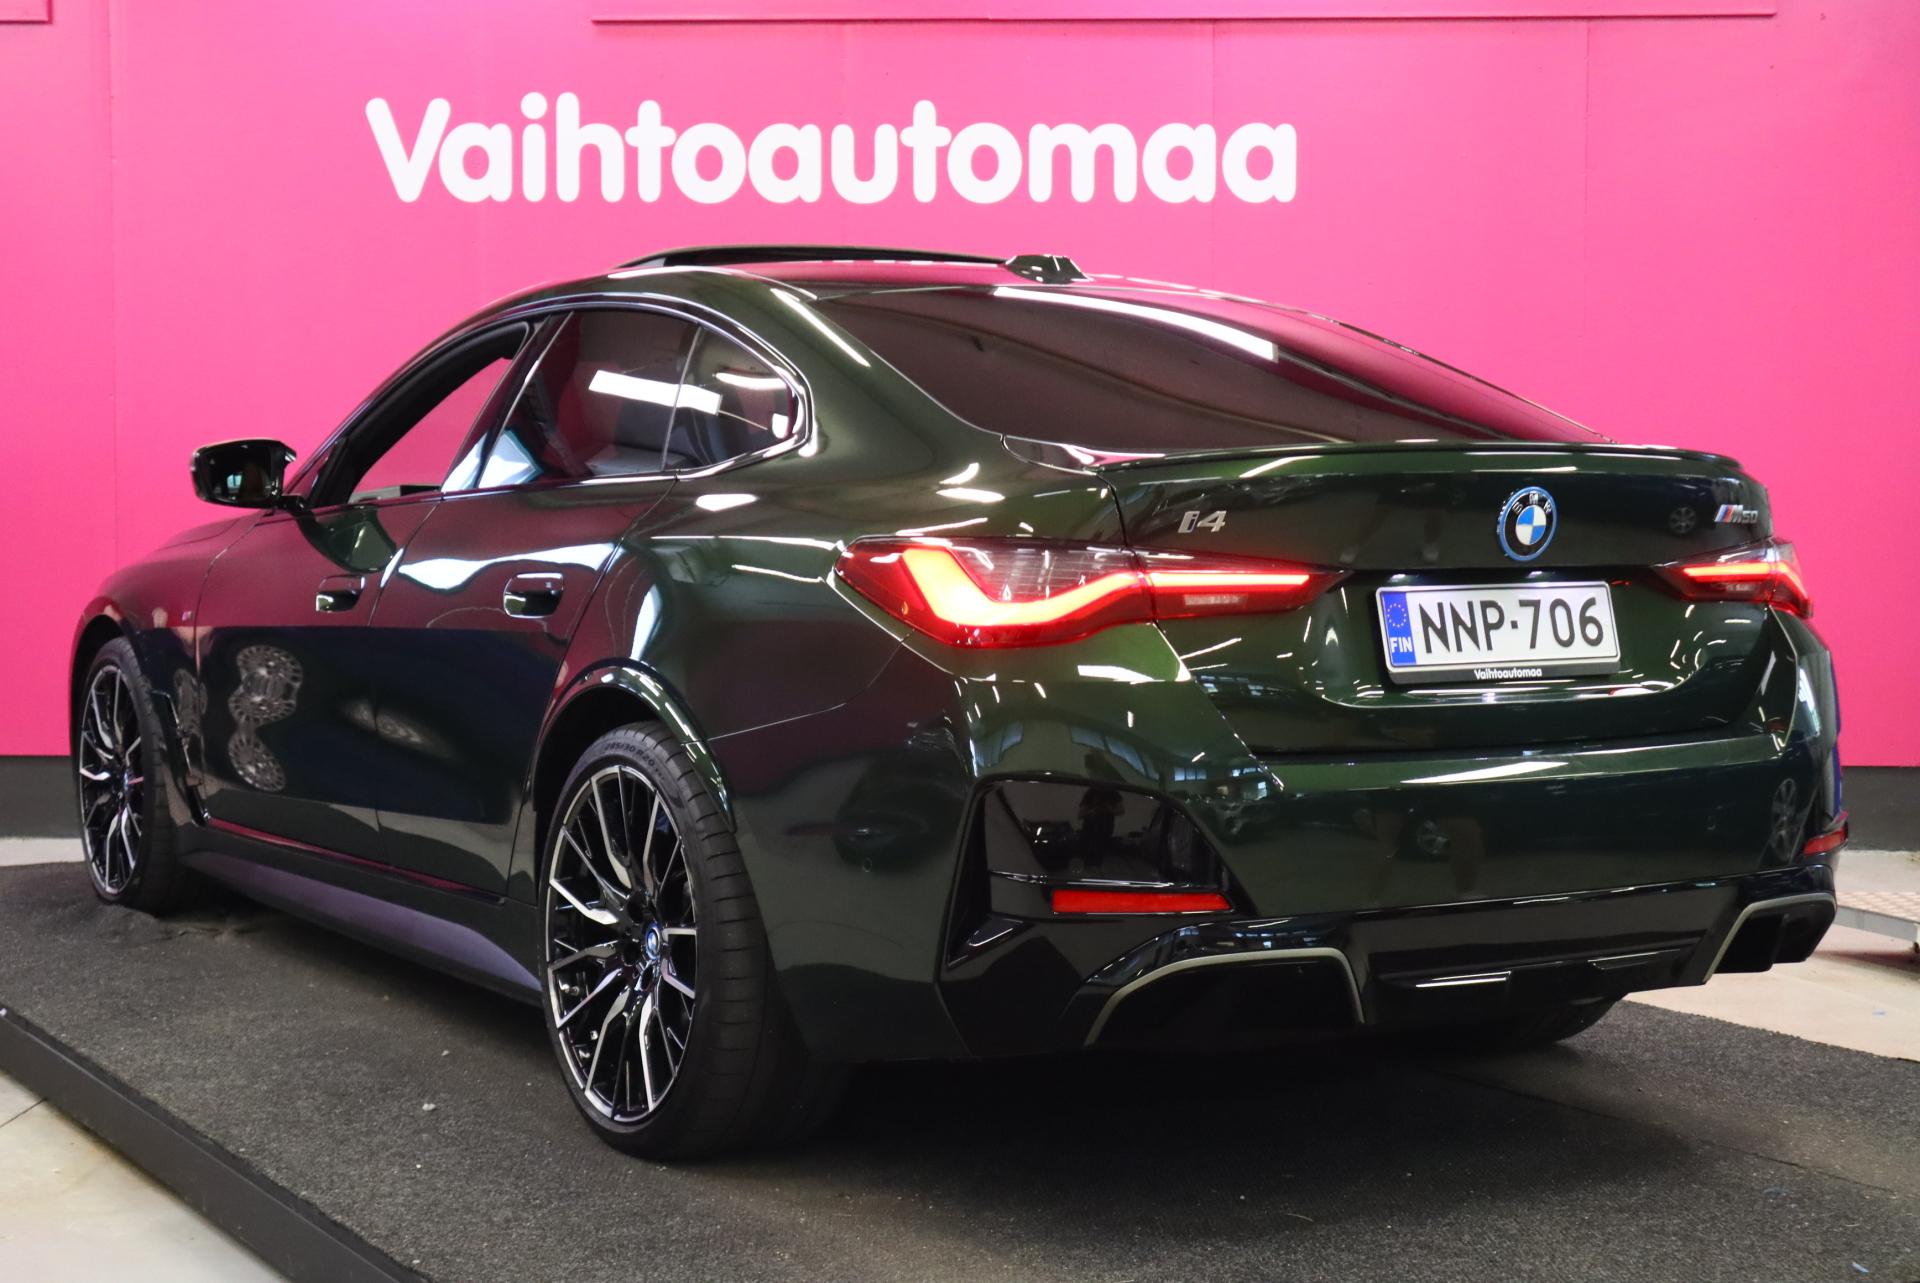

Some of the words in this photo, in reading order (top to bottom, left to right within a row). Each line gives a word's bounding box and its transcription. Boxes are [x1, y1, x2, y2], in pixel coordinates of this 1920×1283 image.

[366, 92, 1297, 204] Vaihtoautomaa
[1178, 510, 1227, 533] i4
[1391, 637, 1413, 653] FIN
[1474, 668, 1542, 680] Vaihtoautomaa
